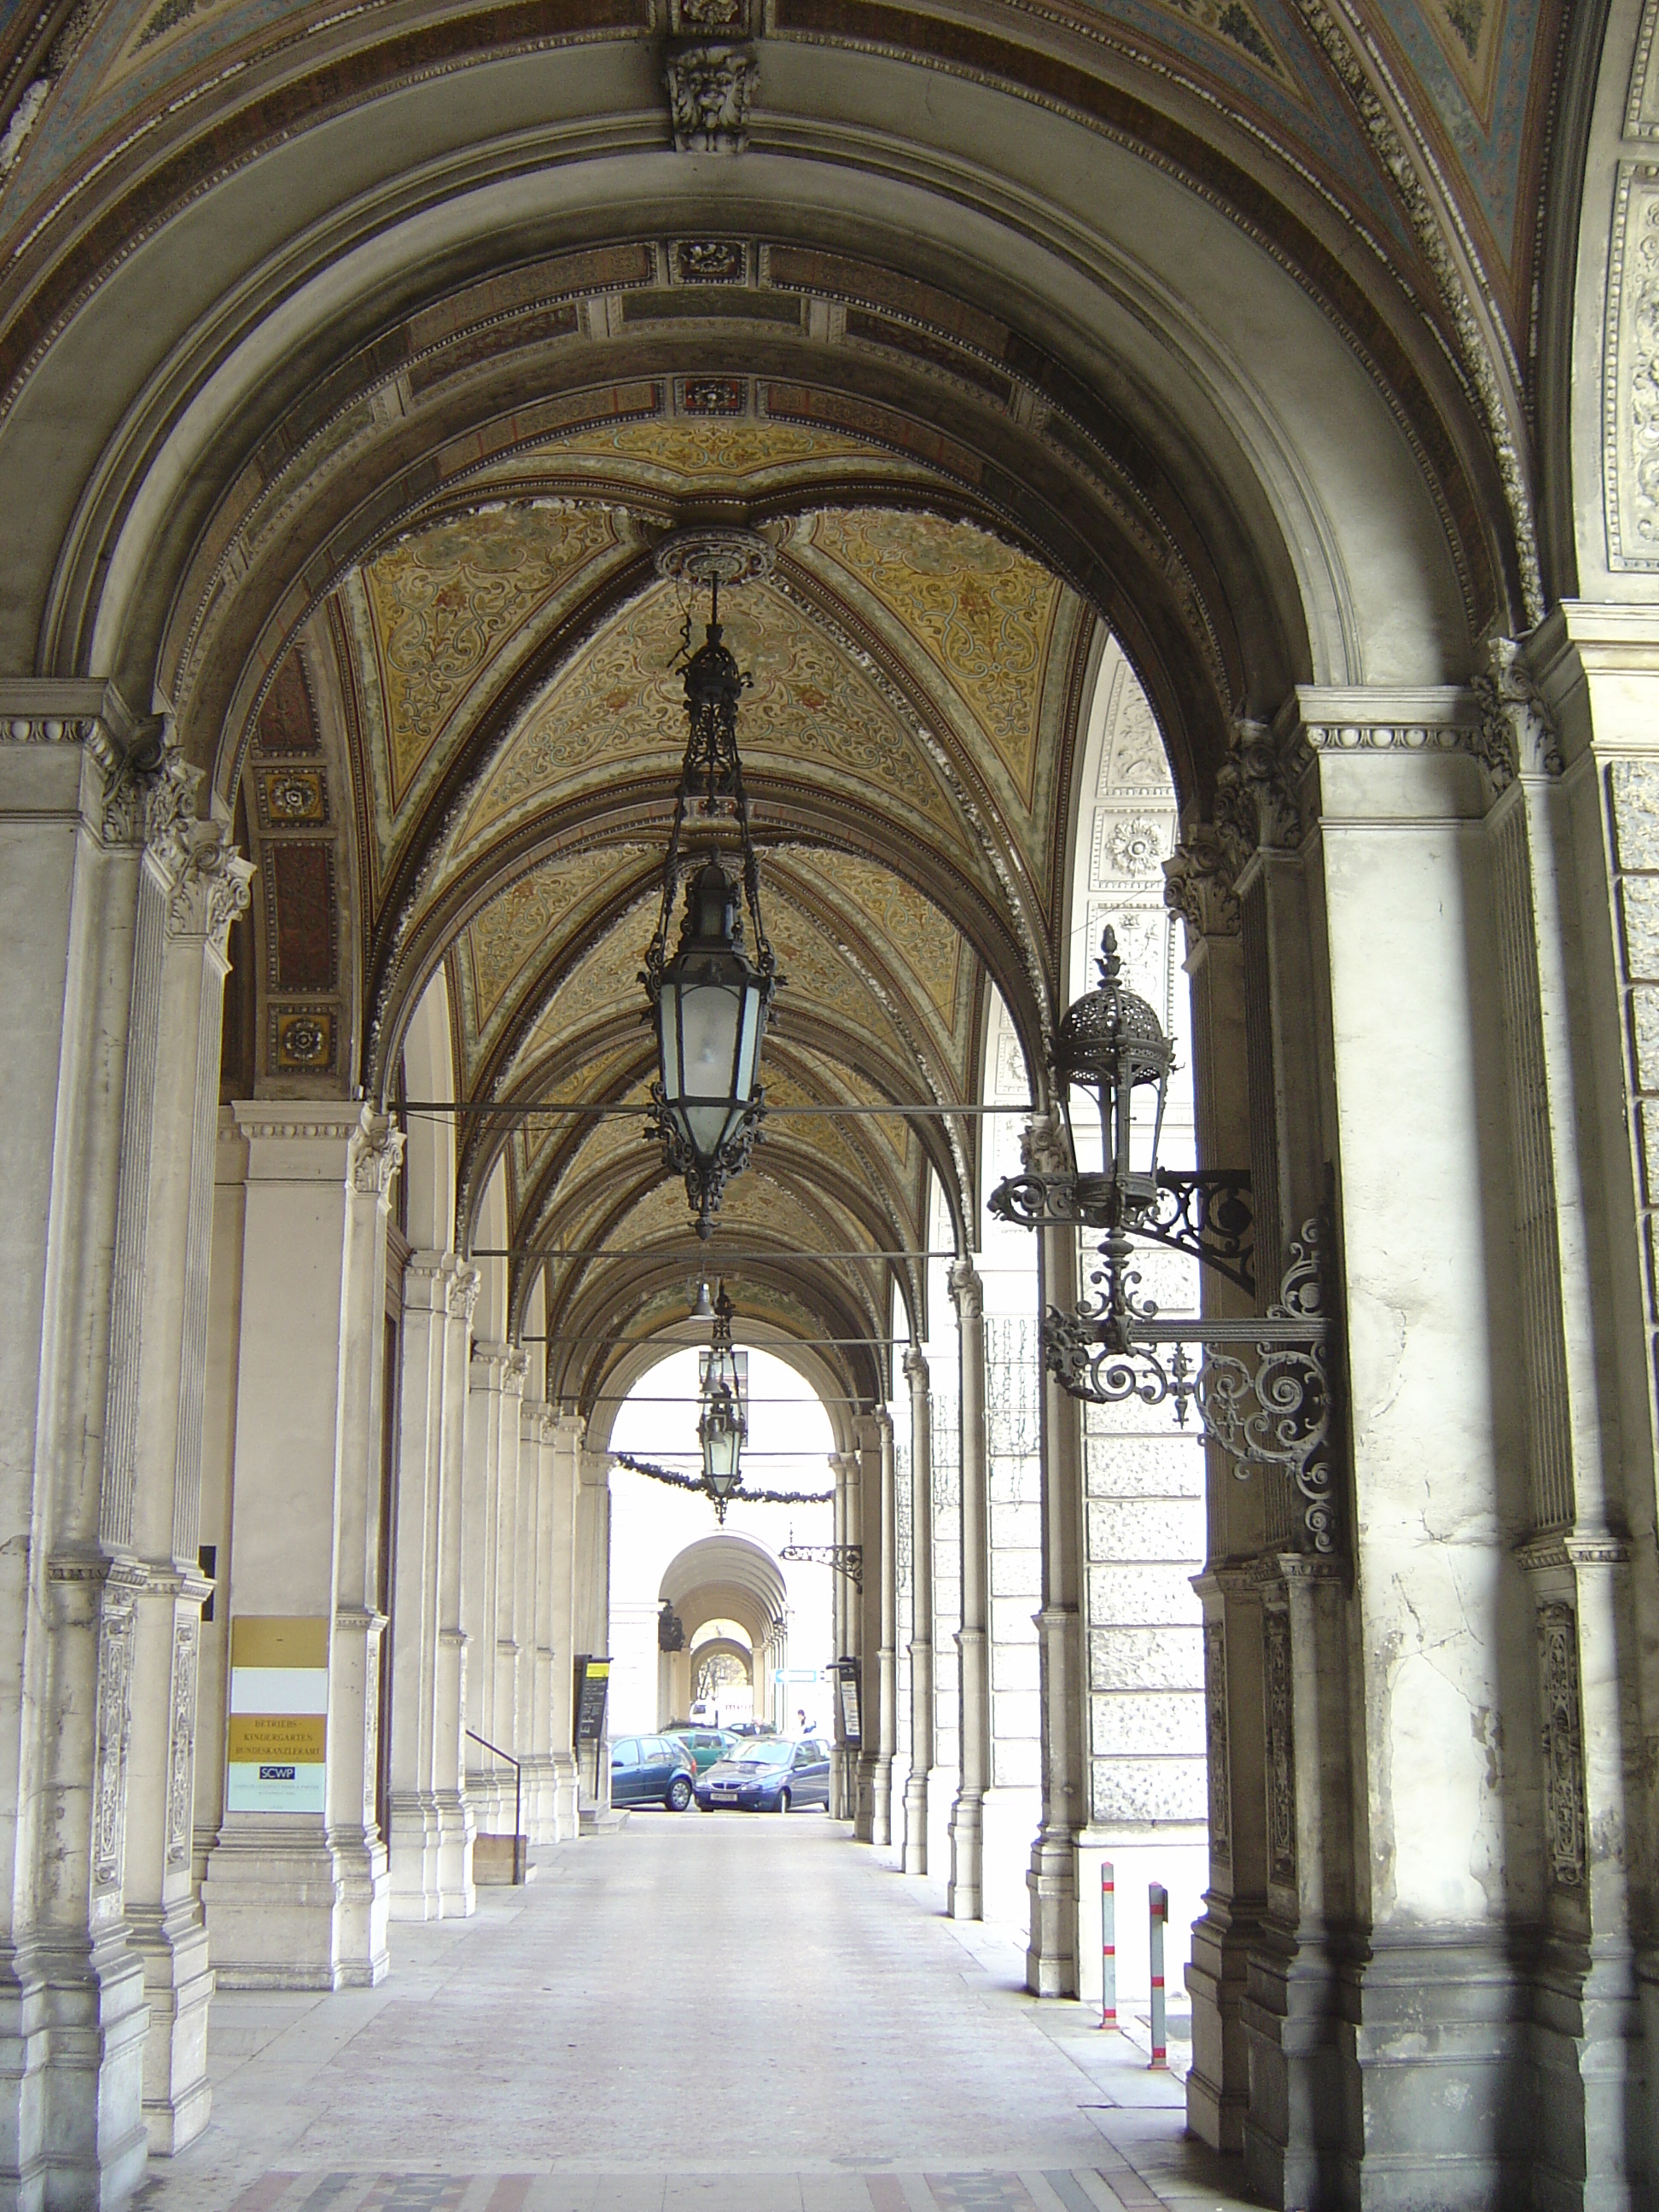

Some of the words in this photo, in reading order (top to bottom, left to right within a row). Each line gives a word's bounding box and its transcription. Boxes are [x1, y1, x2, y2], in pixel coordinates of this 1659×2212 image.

[243, 1733, 312, 1742] KINDERGARTEN
[236, 1746, 320, 1755] BUNDESKANZLERAMT
[260, 1767, 294, 1778] SCWP
